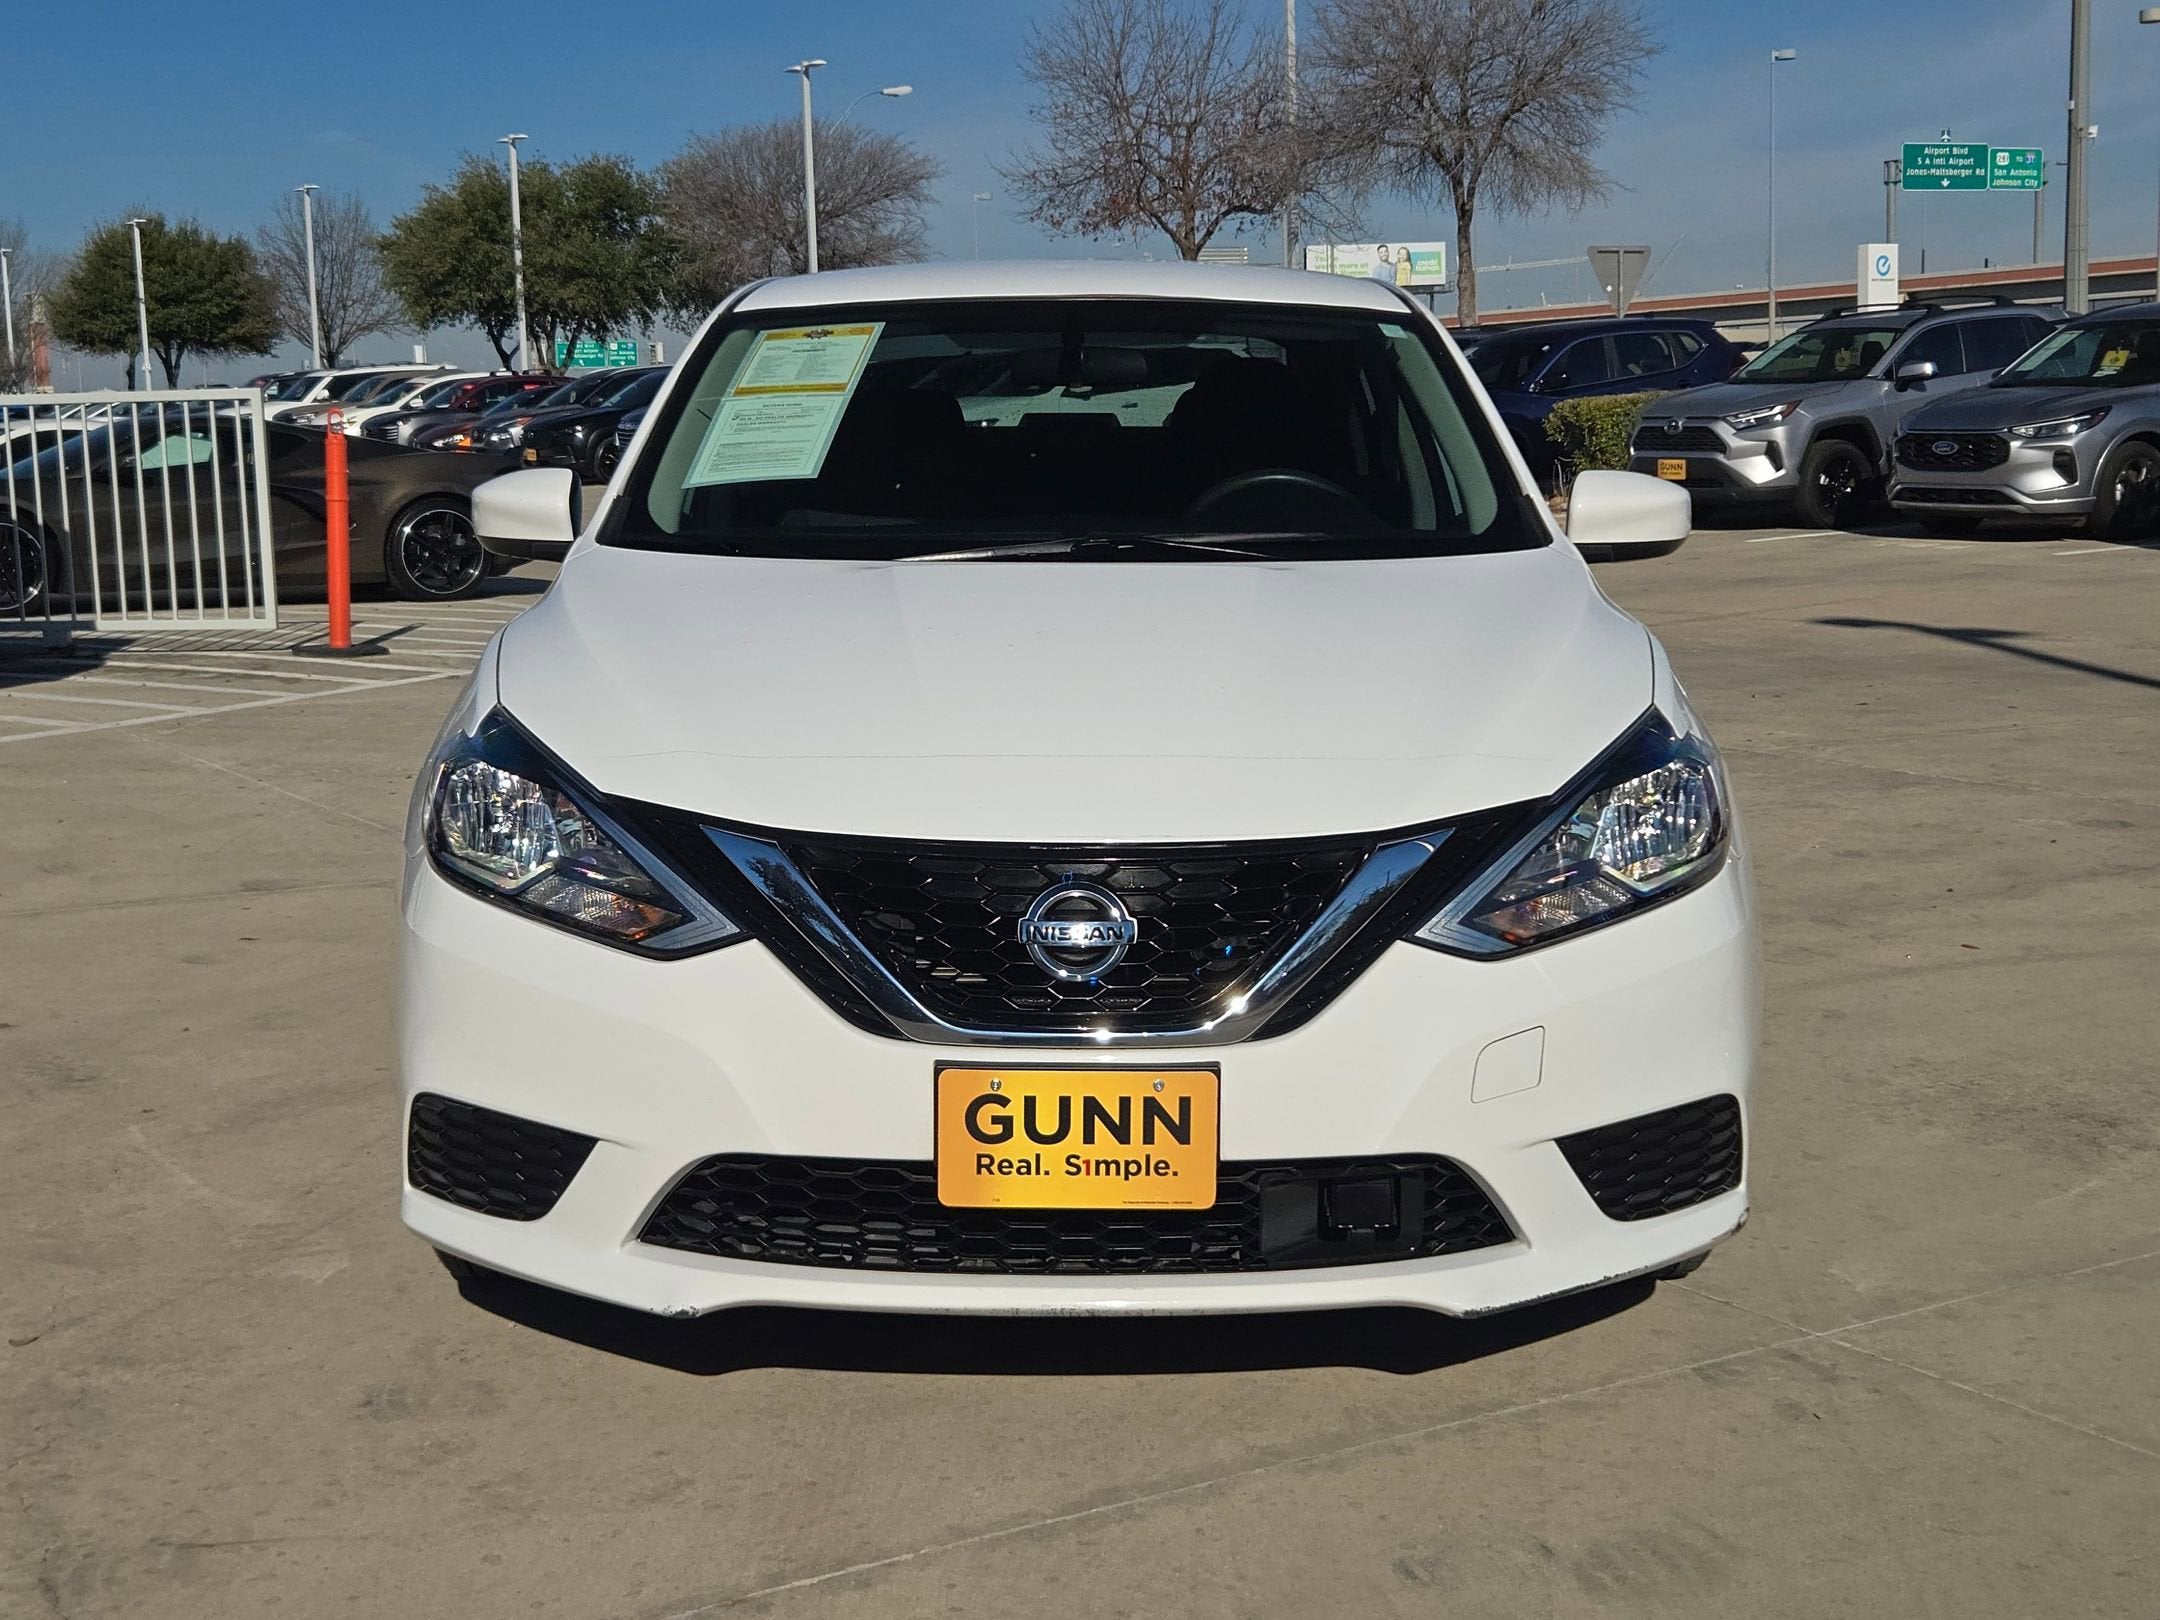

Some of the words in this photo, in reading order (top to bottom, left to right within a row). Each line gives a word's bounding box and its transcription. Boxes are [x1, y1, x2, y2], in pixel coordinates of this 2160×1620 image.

[1923, 146, 1950, 155] Airport
[1952, 146, 1969, 155] Blvd
[1917, 157, 1922, 165] S
[1925, 157, 1931, 165] A
[1948, 157, 1974, 166] Airport
[1905, 168, 1973, 177] Jones-Maltsberger
[1975, 168, 1985, 176] Rd
[1994, 168, 2007, 176] San
[2010, 168, 2038, 176] Antonio
[1992, 178, 2022, 186] Johnson
[2024, 178, 2038, 188] City
[1660, 462, 1683, 471] GUNN
[965, 1093, 1191, 1145] GUNN
[976, 1153, 1050, 1176] Real.
